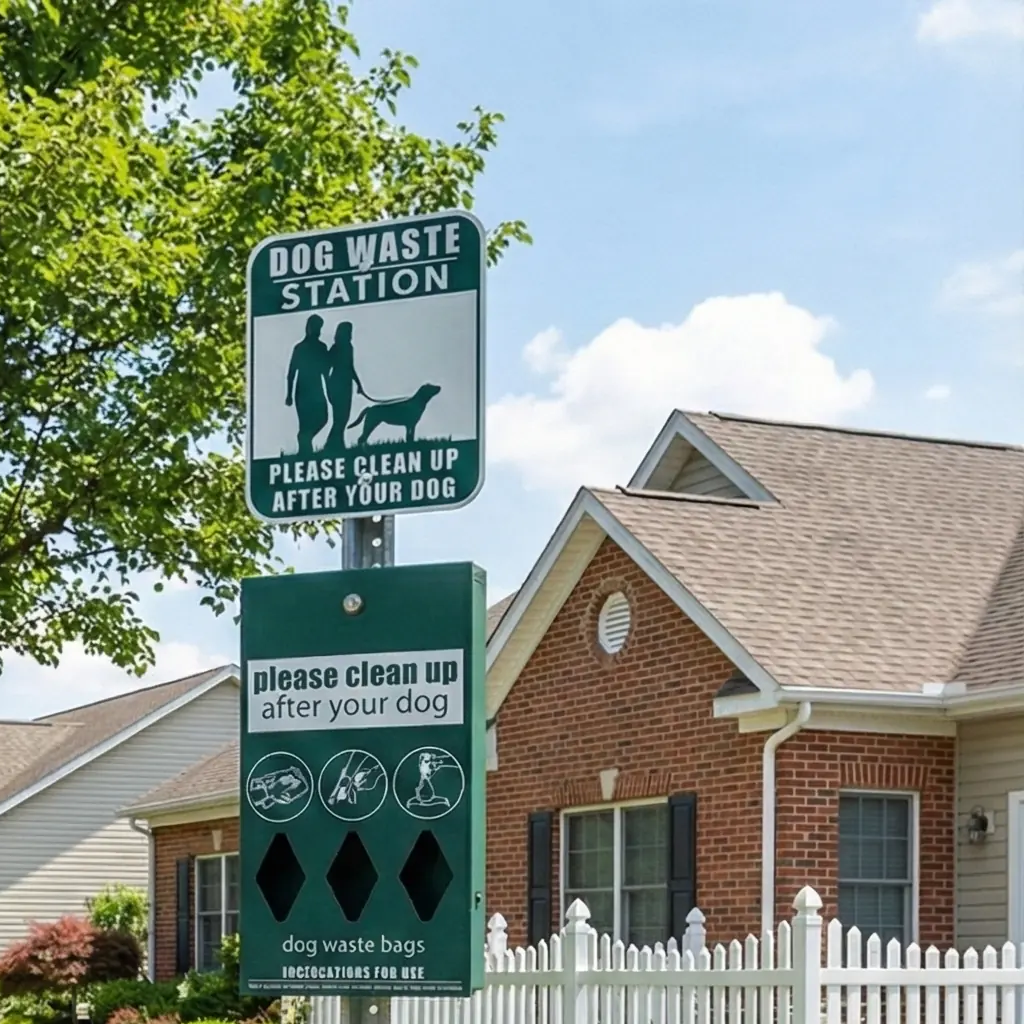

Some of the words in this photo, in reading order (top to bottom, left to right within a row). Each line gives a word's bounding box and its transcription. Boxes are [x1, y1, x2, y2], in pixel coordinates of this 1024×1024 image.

[270, 240, 333, 278] DOG
[346, 222, 460, 268] WASTE
[281, 264, 448, 310] STATION
[269, 457, 346, 485] PLEASE
[353, 451, 421, 478] CLEAN
[430, 447, 459, 471] UP
[272, 486, 337, 513] AFTER
[345, 481, 402, 507] YOUR
[411, 476, 456, 501] DOG
[253, 665, 339, 695] please
[345, 660, 418, 688] clean
[425, 660, 458, 686] up
[261, 693, 322, 720] after
[329, 695, 389, 723] your
[396, 688, 449, 719] dog
[282, 934, 318, 957] dog
[322, 937, 375, 953] waste
[381, 935, 426, 958] bags
[374, 966, 397, 979] FOR
[401, 966, 425, 979] USE
